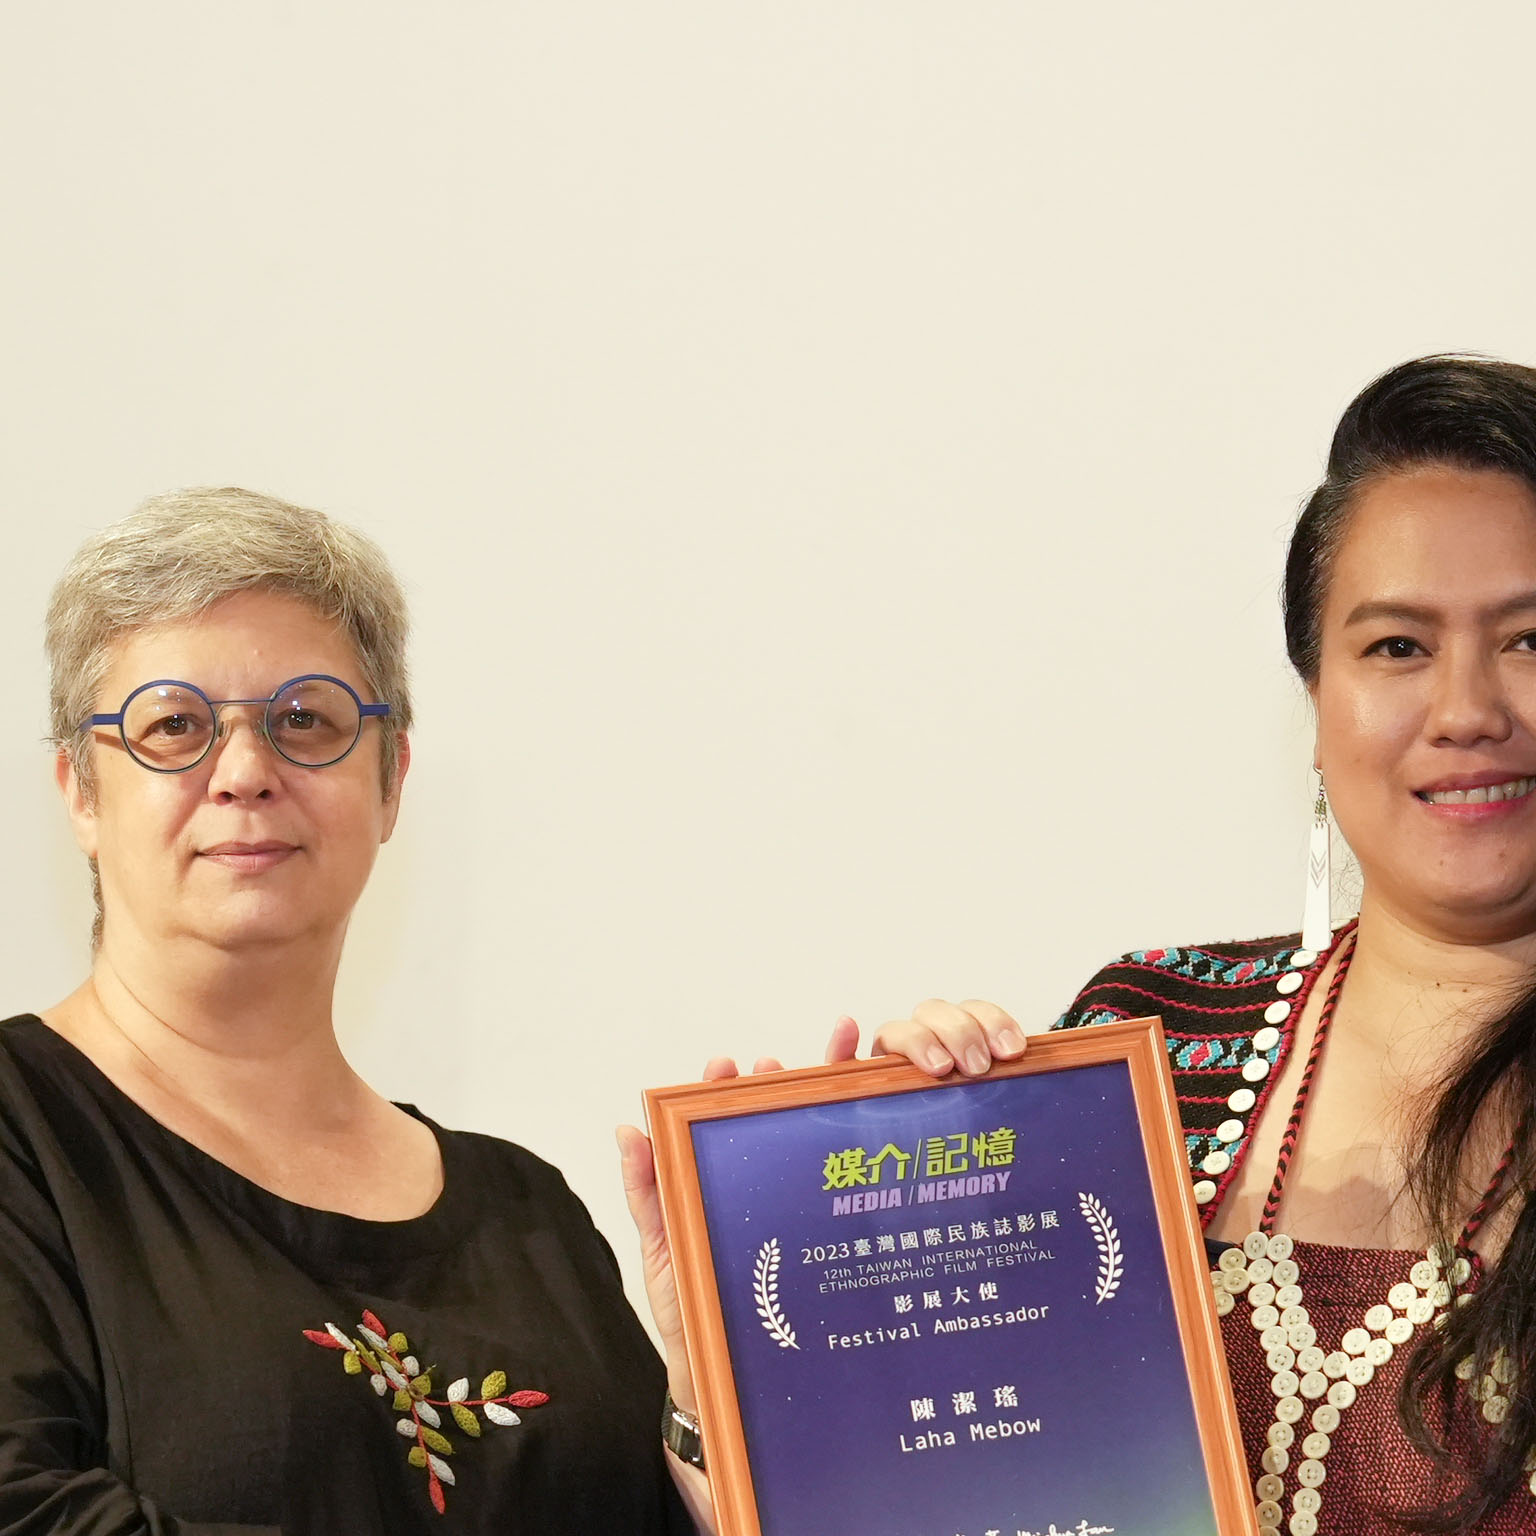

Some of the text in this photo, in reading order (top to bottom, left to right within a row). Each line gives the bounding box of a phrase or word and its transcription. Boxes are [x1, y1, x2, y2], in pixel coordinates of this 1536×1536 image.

[832, 1185, 903, 1218] MEDIA
[917, 1170, 1011, 1204] MEMORY
[819, 1249, 1056, 1294] ETHNOGRAPHIC FILM FESTIVAL
[823, 1239, 1038, 1281] 12th TAIWAN INTERNATIONAL
[893, 1281, 999, 1314] 影展大使
[827, 1304, 1050, 1350] Festival Ambassador
[910, 1384, 1020, 1423] 陳潔瑤
[899, 1414, 1042, 1454] Laha Mebow
